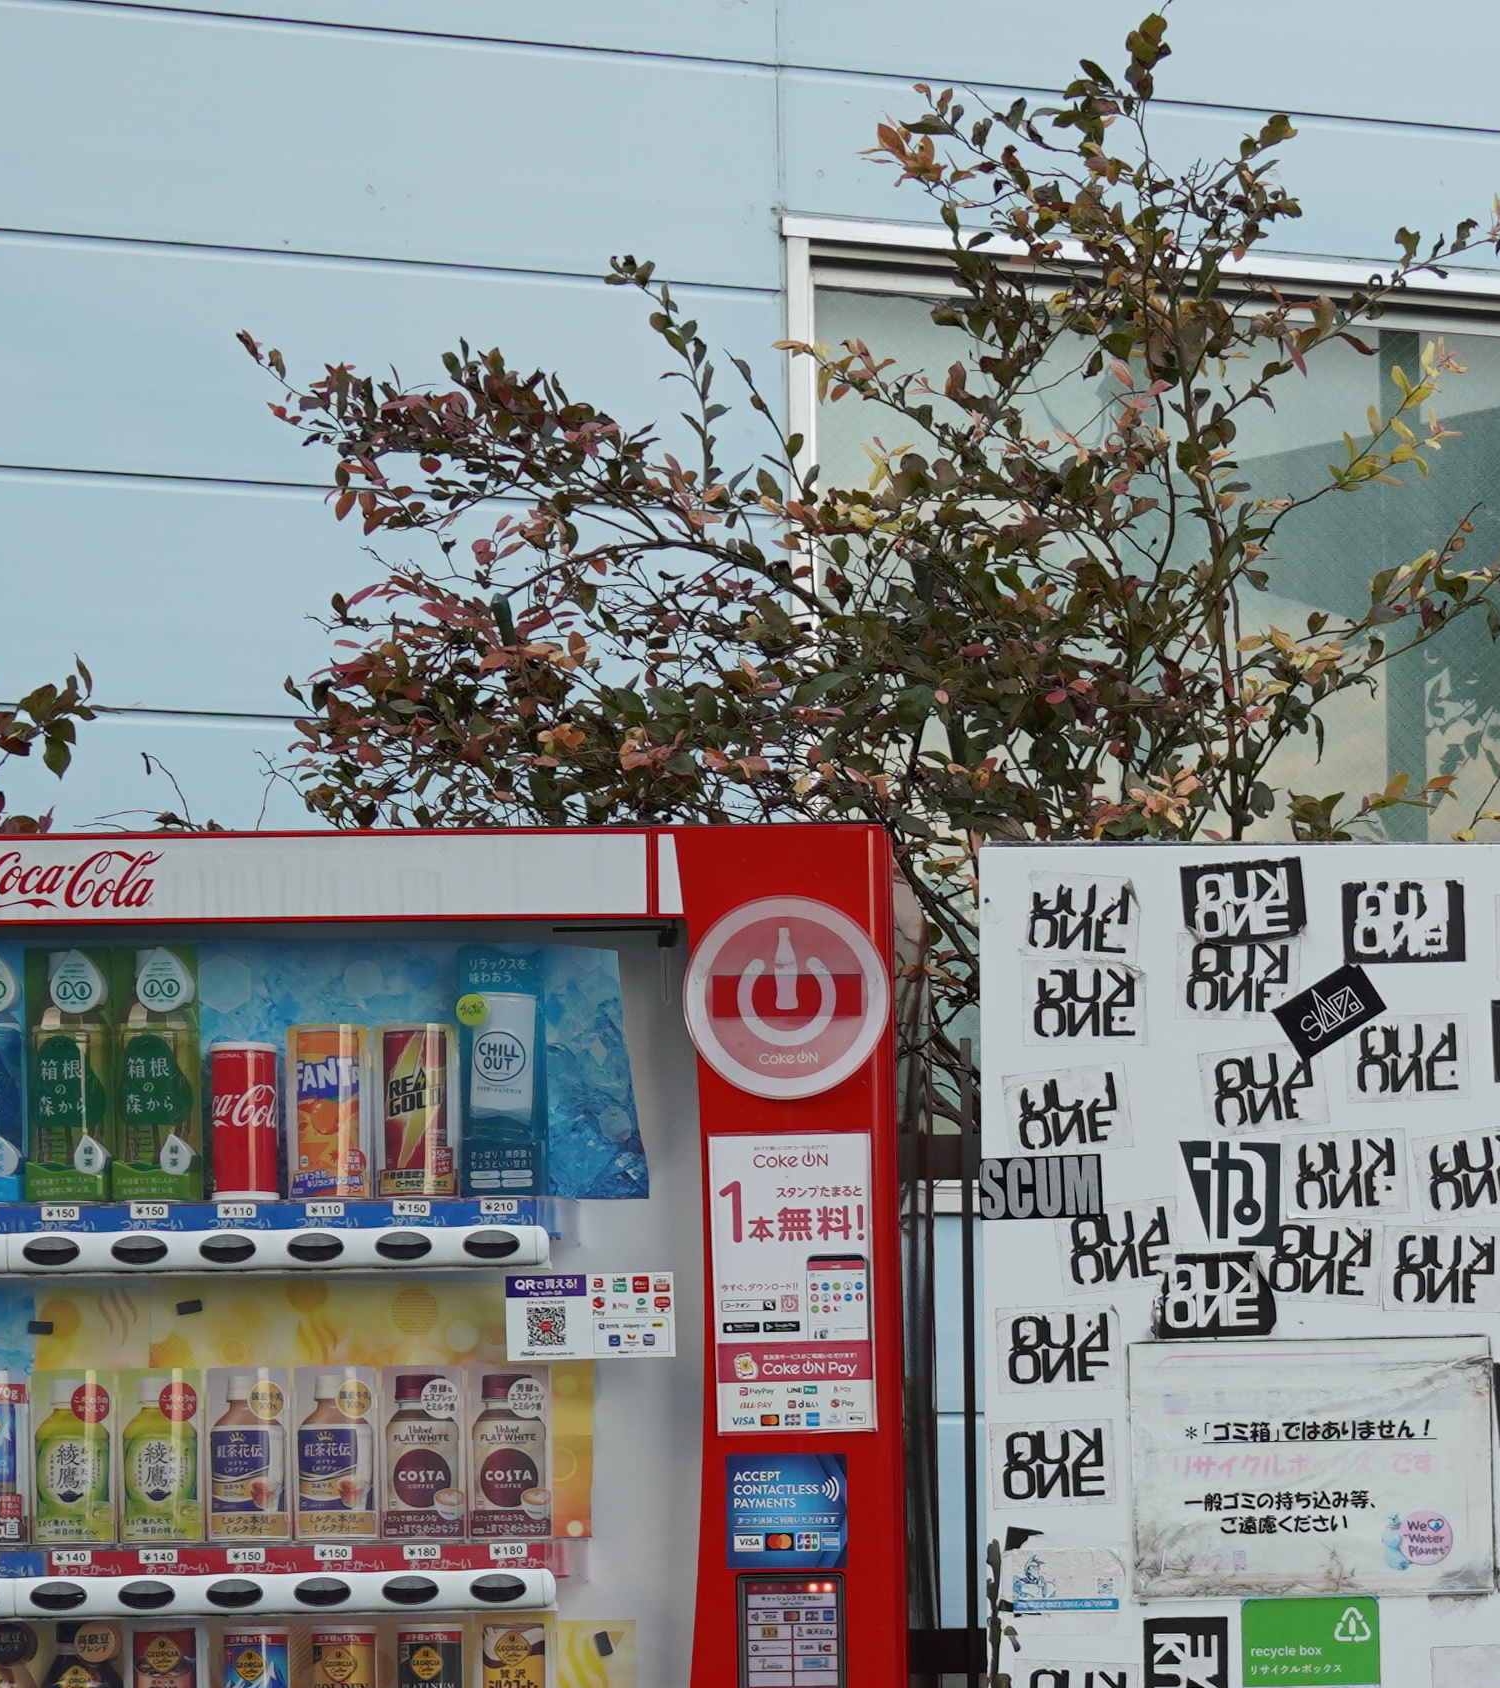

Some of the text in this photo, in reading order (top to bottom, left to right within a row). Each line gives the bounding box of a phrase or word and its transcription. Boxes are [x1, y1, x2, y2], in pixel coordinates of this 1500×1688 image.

[479, 1042, 520, 1059] CHILL
[127, 1057, 170, 1078] 箱根
[483, 1056, 512, 1071] OUT
[126, 1093, 174, 1115] 森から
[753, 1154, 799, 1168] Coke
[776, 1186, 863, 1198] スタンプたまると
[980, 1157, 1101, 1218] SCUM
[762, 1361, 800, 1375] Coke
[828, 1361, 857, 1378] Pay
[732, 1416, 756, 1426] VISA
[394, 1434, 450, 1442] FLAT WHITE
[215, 1444, 264, 1458] 紅茶花伝
[56, 1442, 81, 1489] 綾鷹
[398, 1469, 446, 1482] COSTA
[734, 1471, 781, 1483] ACCEPT
[733, 1484, 820, 1496] CONTACTLESS
[733, 1497, 797, 1509] PAYMENTS
[1184, 1490, 1376, 1512] 一般ゴミの持ち込み等、
[1220, 1515, 1348, 1534] ご遠慮ください
[77, 1632, 109, 1645] 高級豆
[1250, 1644, 1323, 1657] recycle box
[1250, 1664, 1343, 1676] リサイクルボックス
